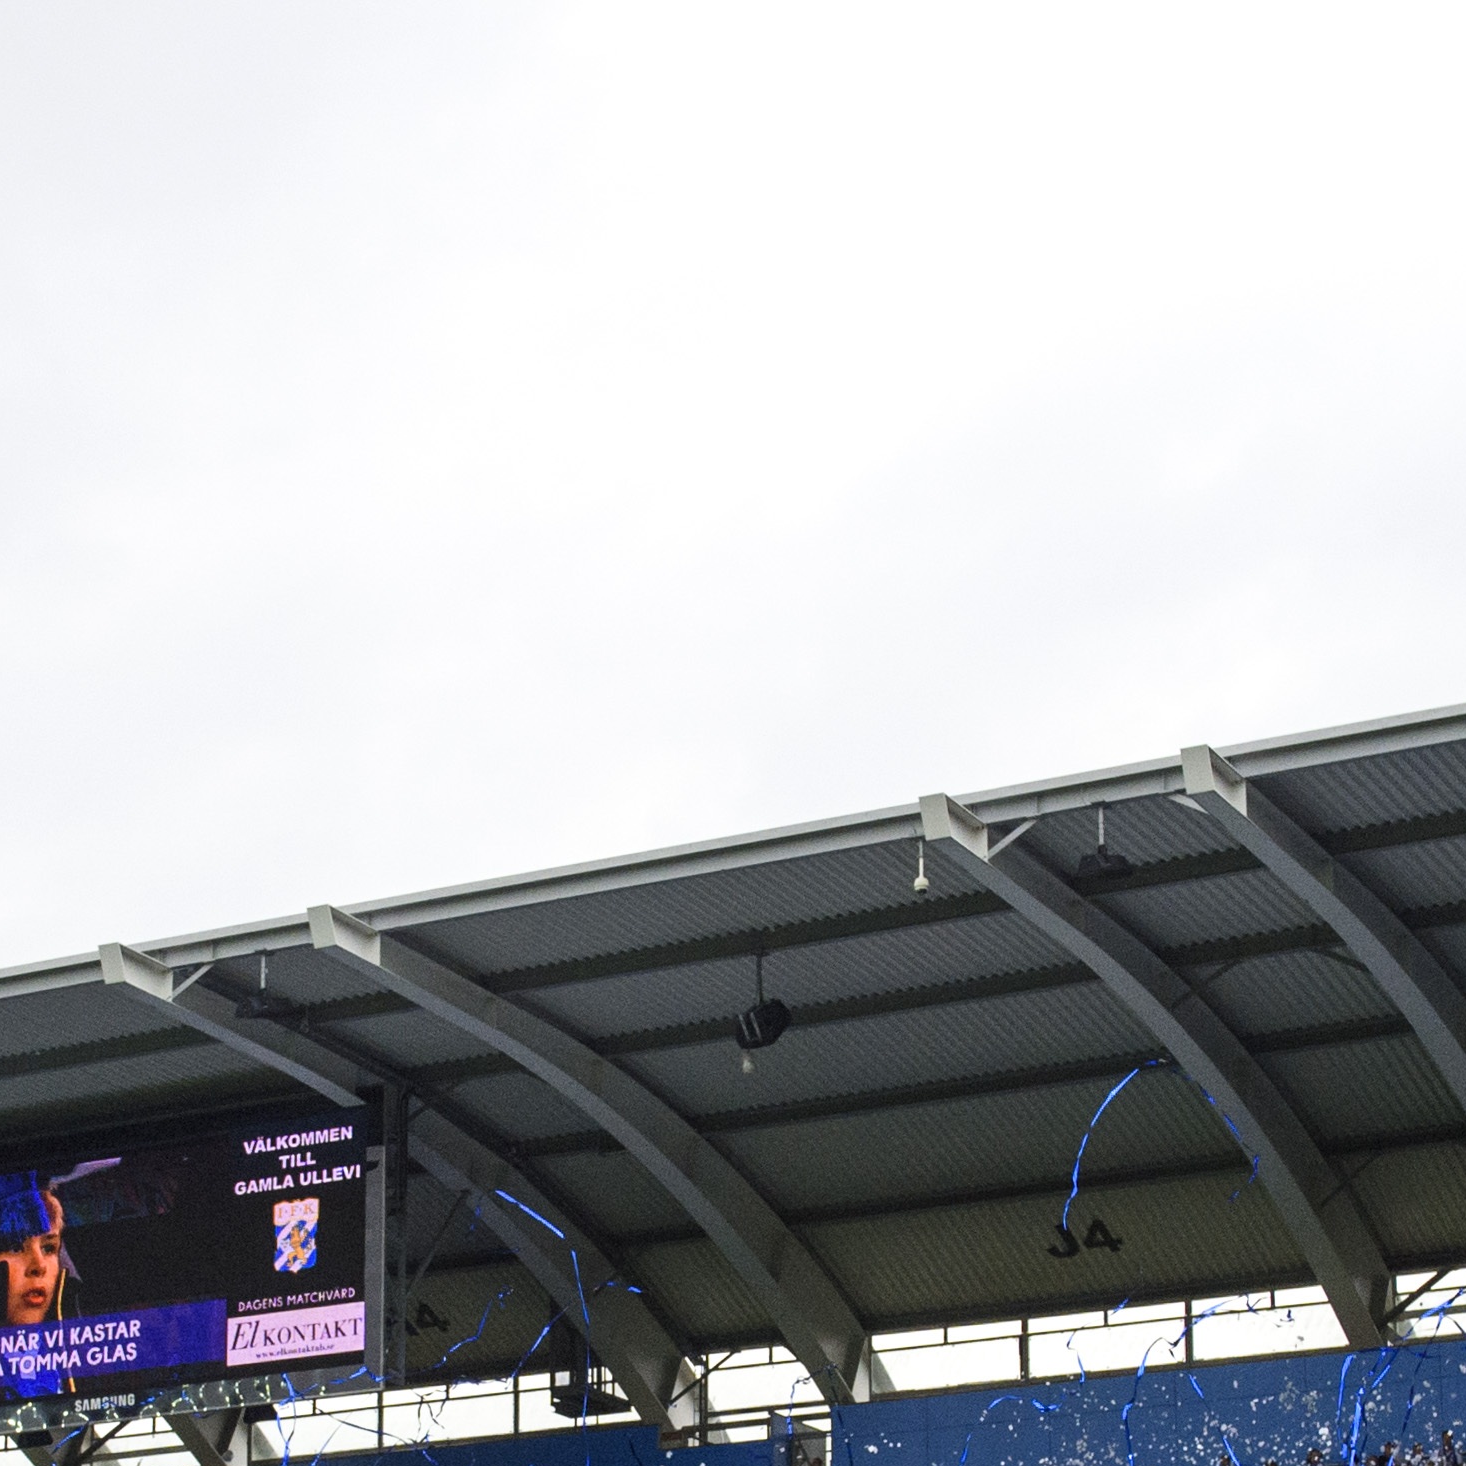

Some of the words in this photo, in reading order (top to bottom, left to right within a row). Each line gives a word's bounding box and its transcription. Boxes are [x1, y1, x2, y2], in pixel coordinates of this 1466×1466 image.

[243, 1125, 353, 1155] VÄLKOMMEN
[278, 1151, 316, 1169] TILL
[234, 1174, 295, 1195] GAMLA
[299, 1164, 361, 1186] ULLEVI
[1047, 1218, 1123, 1259] J4
[238, 1296, 283, 1312] DAGENS
[1, 1330, 39, 1354] NÄR
[45, 1328, 64, 1348] VI
[70, 1319, 141, 1346] KASTAR
[8, 1350, 81, 1375] TOMMA
[86, 1342, 138, 1366] GLAS
[74, 1393, 136, 1413] SAMSUNG
